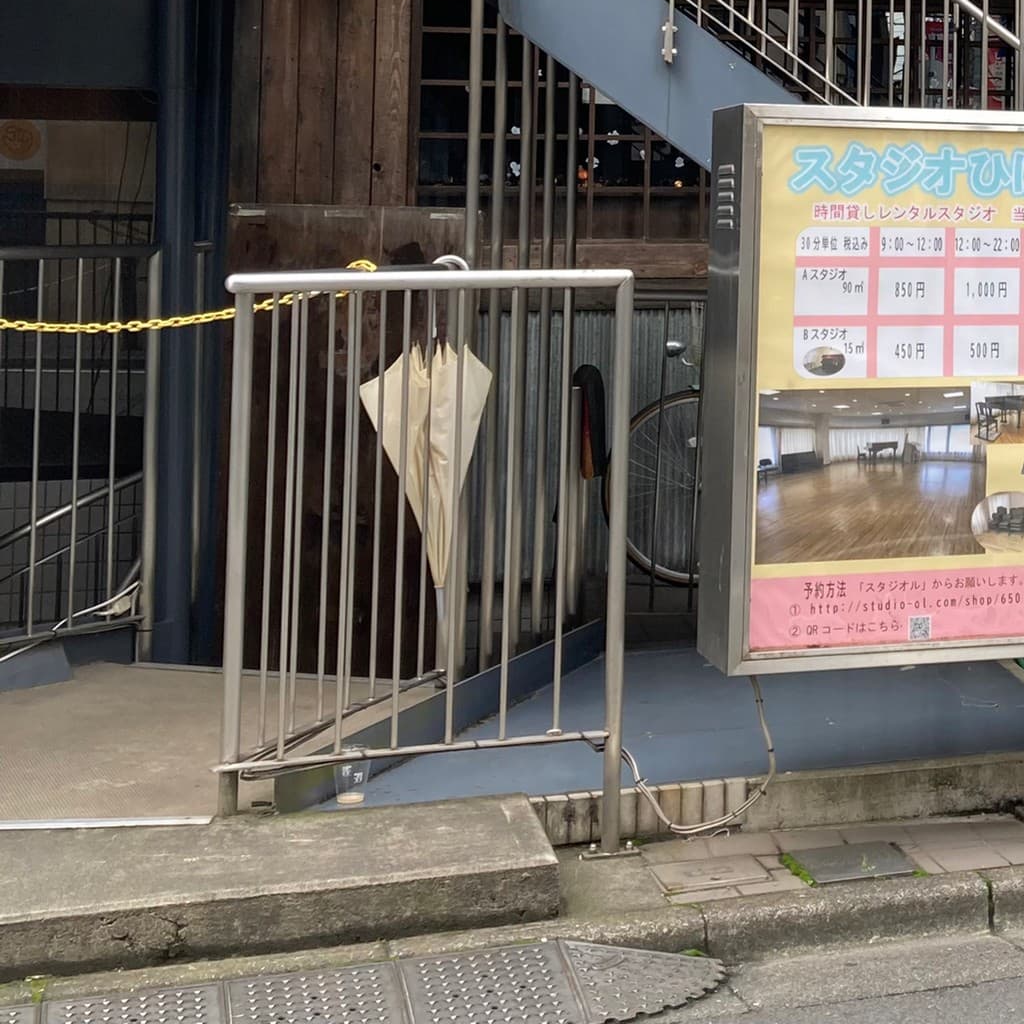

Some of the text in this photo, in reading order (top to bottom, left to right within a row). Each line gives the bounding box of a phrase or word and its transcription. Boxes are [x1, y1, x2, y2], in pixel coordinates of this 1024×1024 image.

[813, 204, 997, 223] 時間貸しレンタルスタジオ
[895, 282, 925, 298] 850円
[966, 282, 1007, 298] 1,000円
[895, 343, 925, 360] 450円
[970, 342, 1000, 359] 500円
[803, 581, 848, 600] 予約方法
